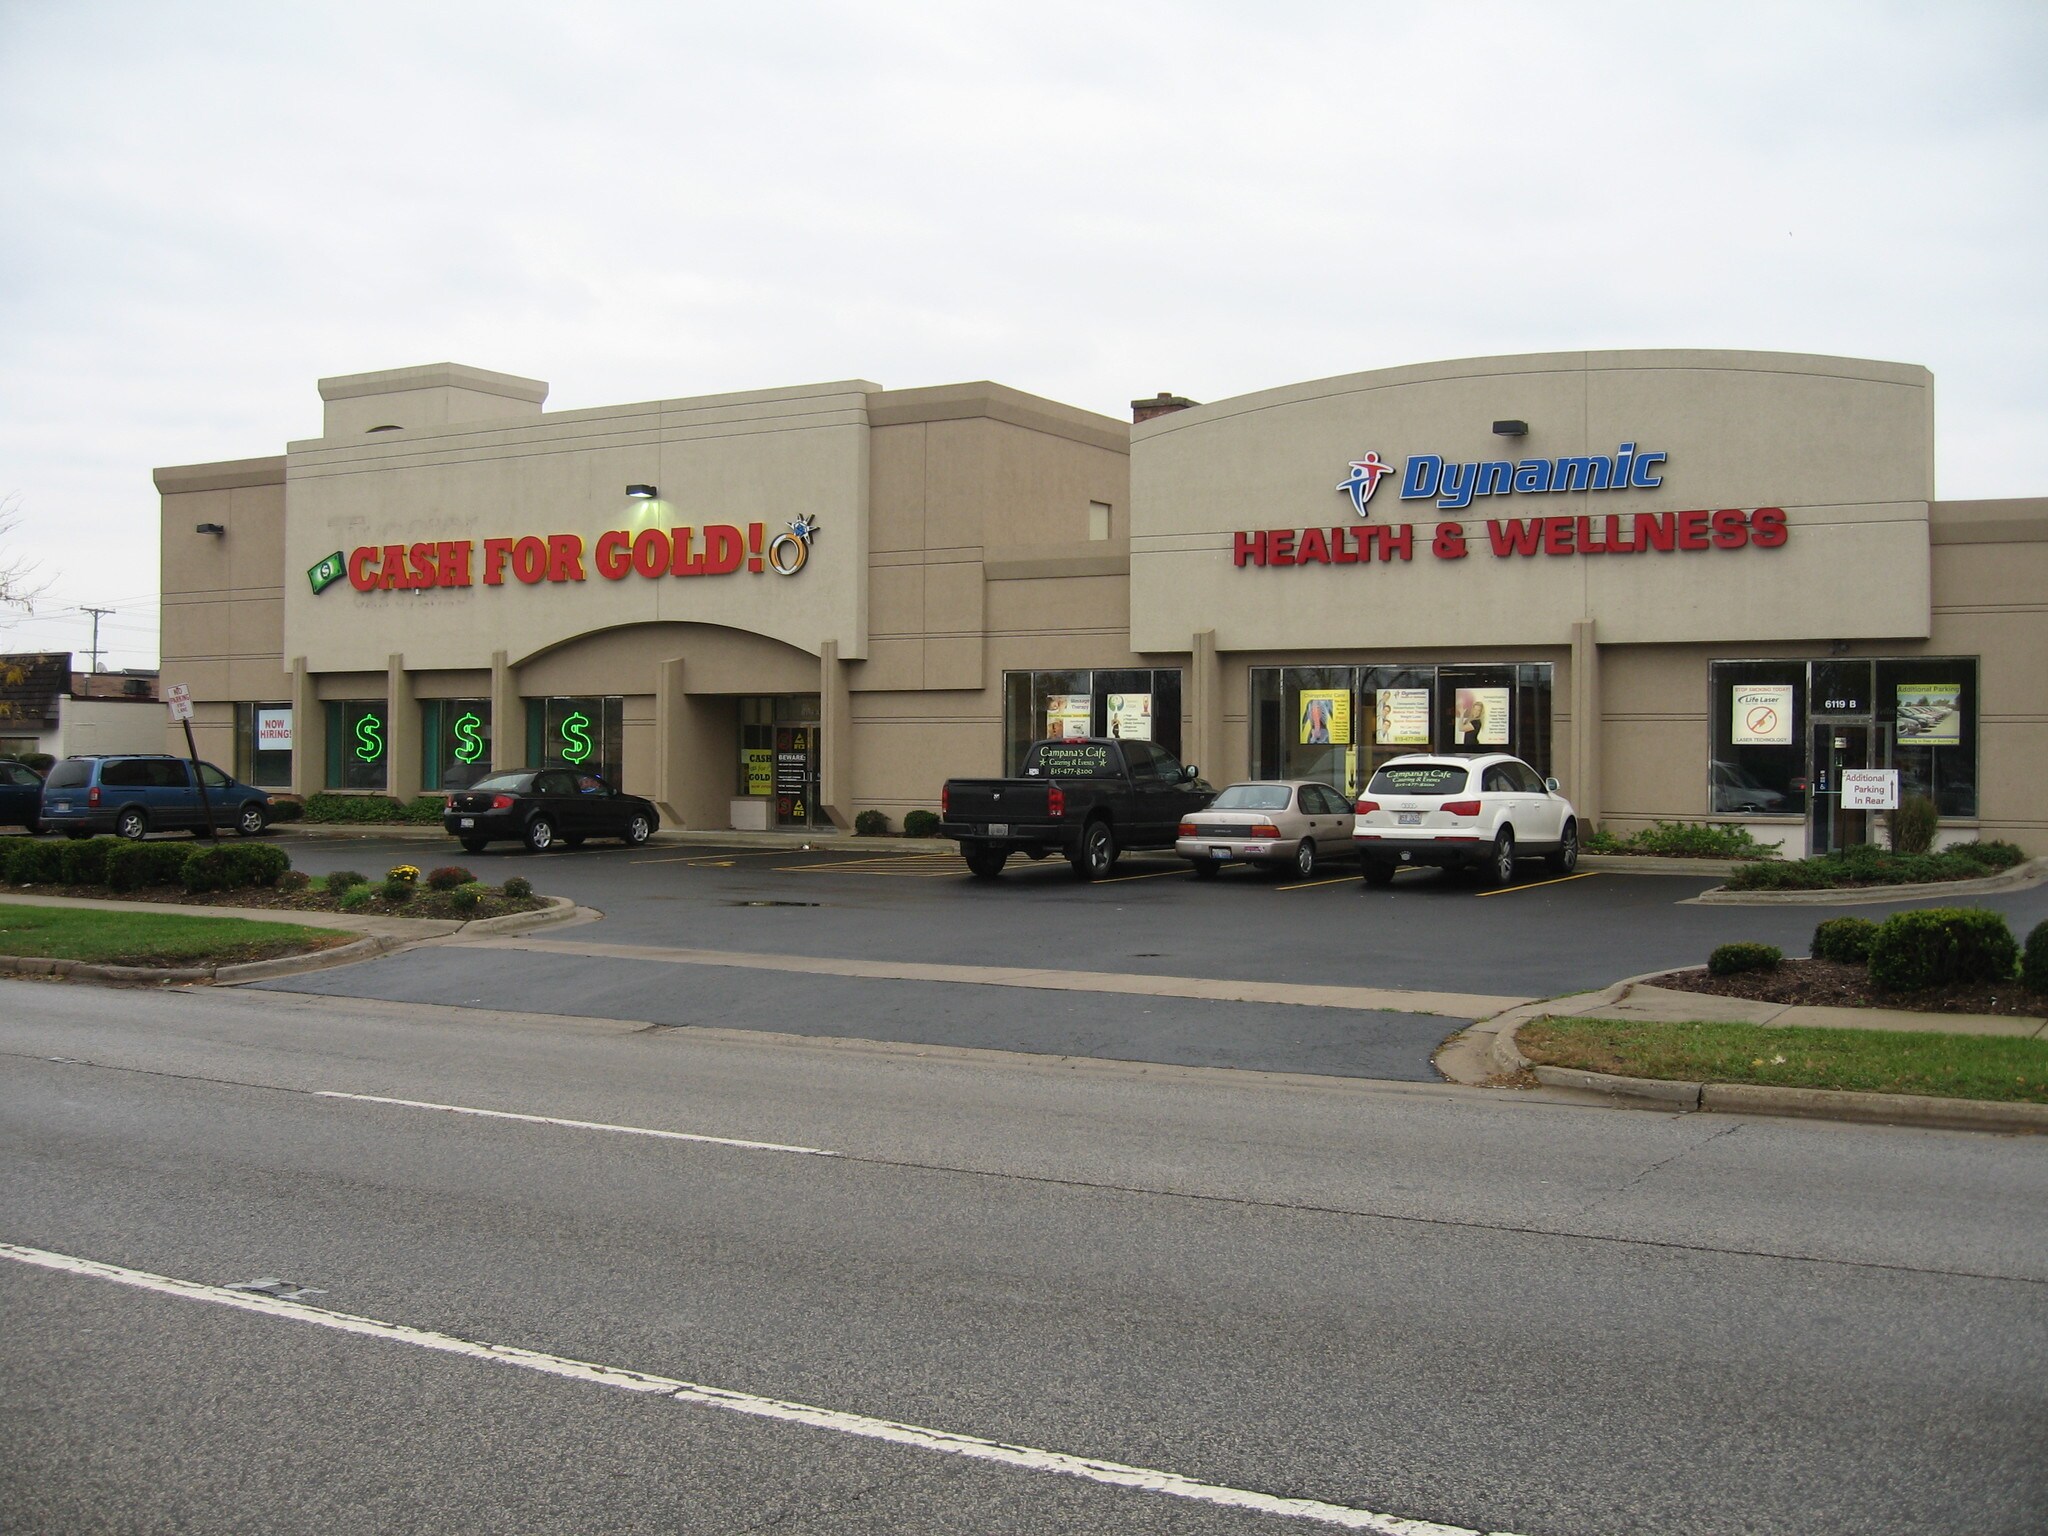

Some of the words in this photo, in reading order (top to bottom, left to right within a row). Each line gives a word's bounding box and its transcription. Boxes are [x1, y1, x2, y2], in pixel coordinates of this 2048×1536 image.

[1399, 442, 1668, 509] Dynamic
[1233, 522, 1413, 567] HEALTH
[1432, 521, 1468, 559] &
[1487, 506, 1788, 557] WELLNESS
[347, 540, 474, 592] CASH
[483, 534, 587, 585] FOR
[595, 522, 766, 580] GOLD!
[1825, 700, 1846, 709] 6119
[1849, 700, 1857, 709] B
[265, 720, 285, 728] NOW
[260, 730, 292, 739] HIRING!
[1040, 746, 1084, 758] Campana's
[1085, 746, 1106, 758] Cafe
[749, 754, 772, 762] CASH
[1386, 770, 1430, 778] Campana's
[1430, 770, 1452, 778] Cafe
[1854, 785, 1885, 795] Parking
[1854, 796, 1863, 804] In
[1865, 796, 1885, 804] Rear
